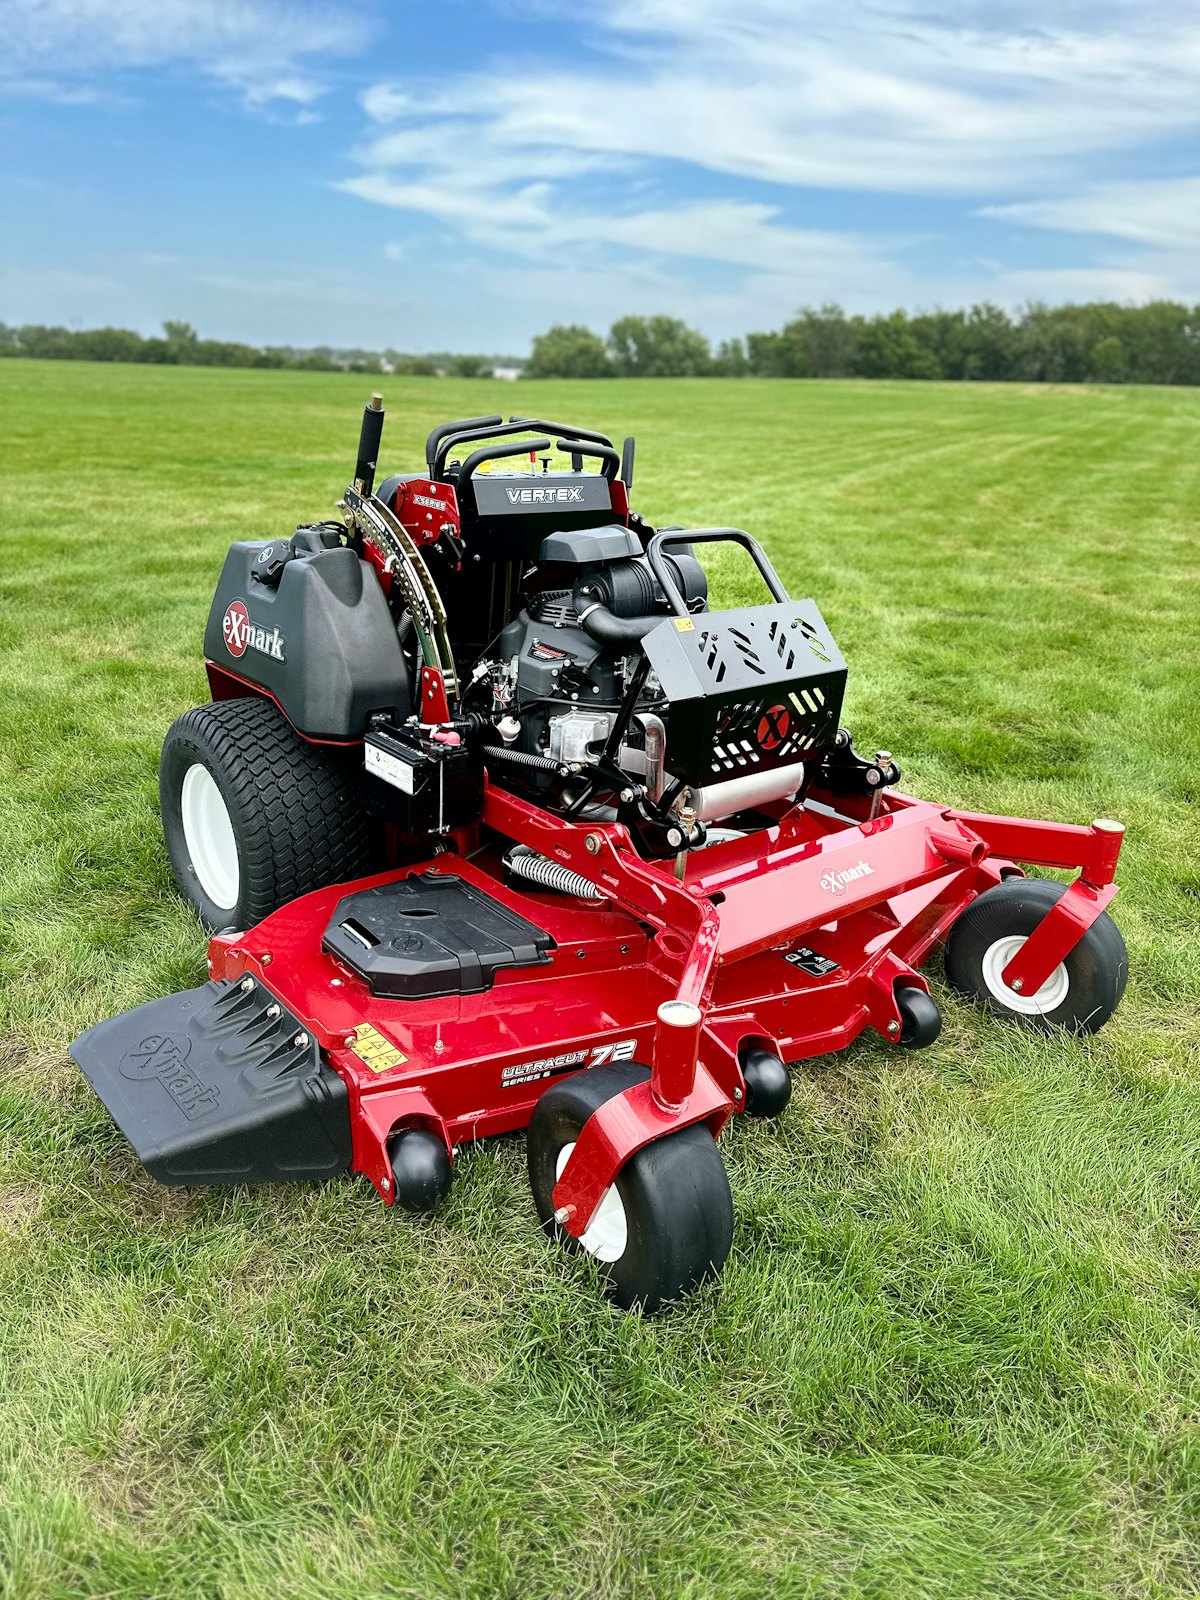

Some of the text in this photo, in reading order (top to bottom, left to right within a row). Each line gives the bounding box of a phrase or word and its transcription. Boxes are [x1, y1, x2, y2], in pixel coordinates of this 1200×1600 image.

[506, 487, 584, 504] VERTEX
[223, 609, 285, 661] eXmark
[820, 860, 876, 893] eXmark
[501, 1040, 637, 1079] ULTRACUT 72
[501, 1073, 541, 1088] SERIES
